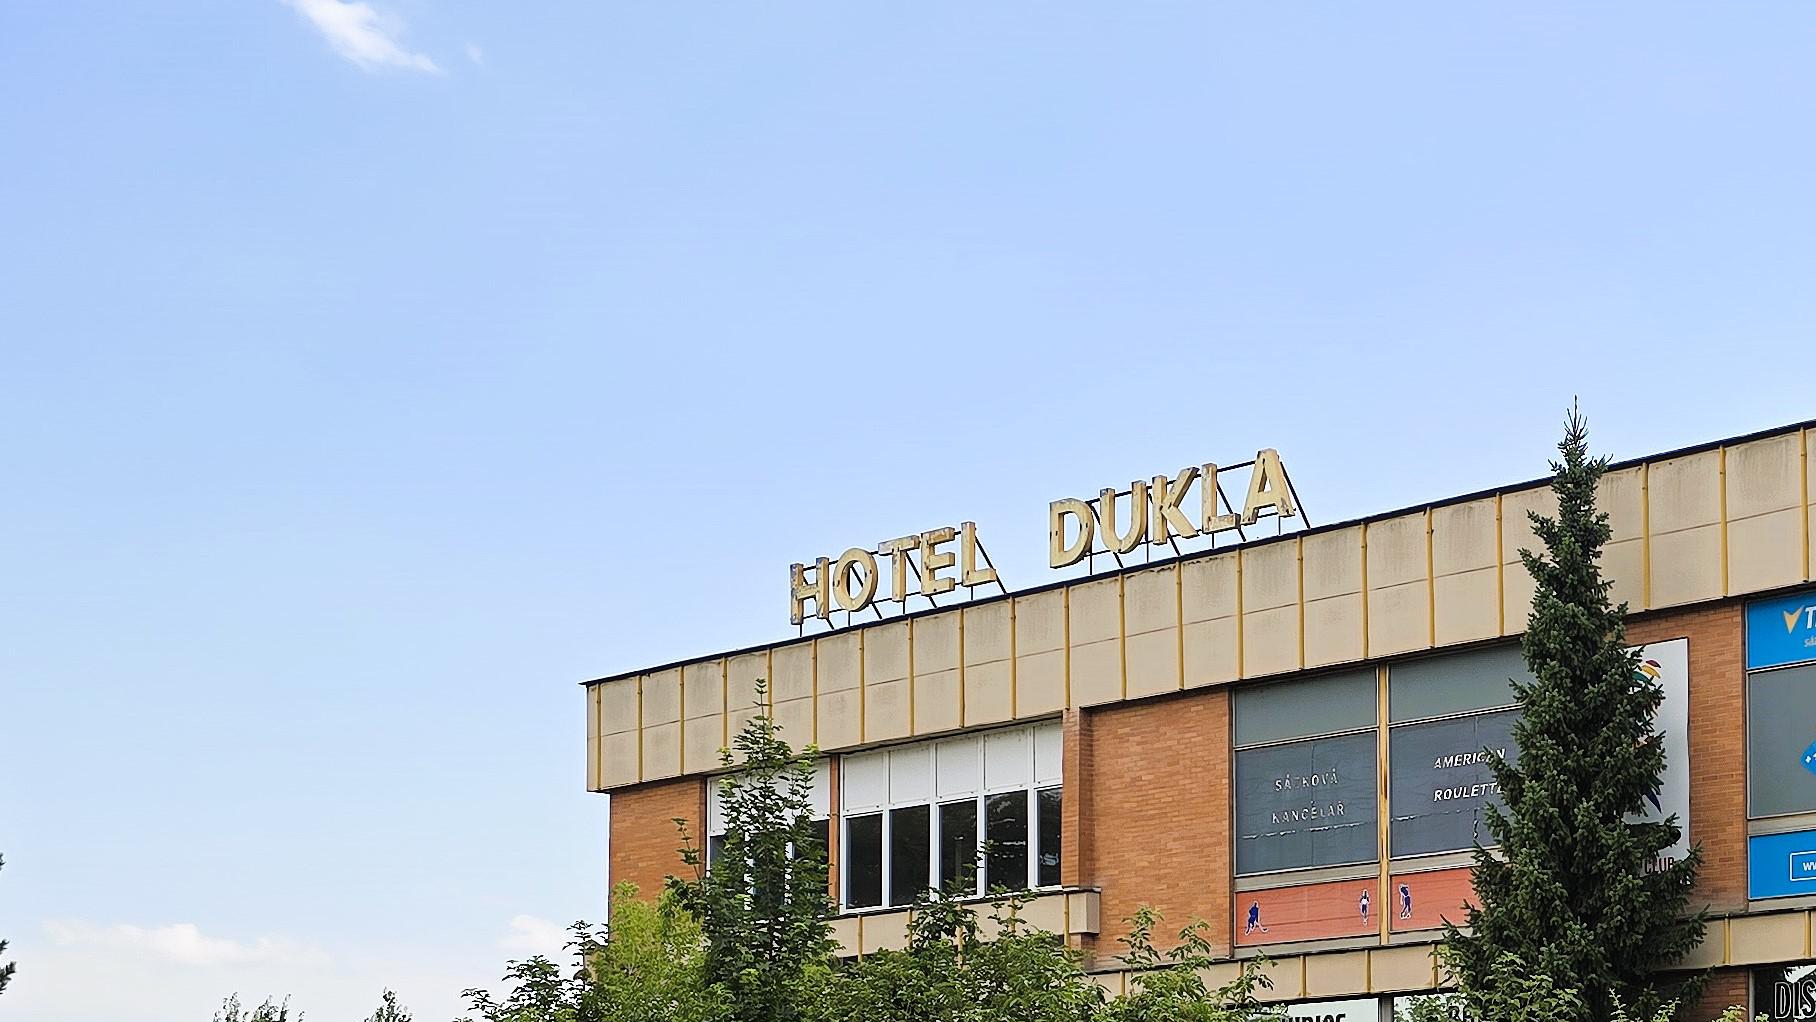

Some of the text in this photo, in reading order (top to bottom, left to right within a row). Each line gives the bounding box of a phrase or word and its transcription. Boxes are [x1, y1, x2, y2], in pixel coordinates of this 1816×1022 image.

[790, 448, 1295, 625] HOTEL DUKLA
[1434, 748, 1506, 769] AMERICN
